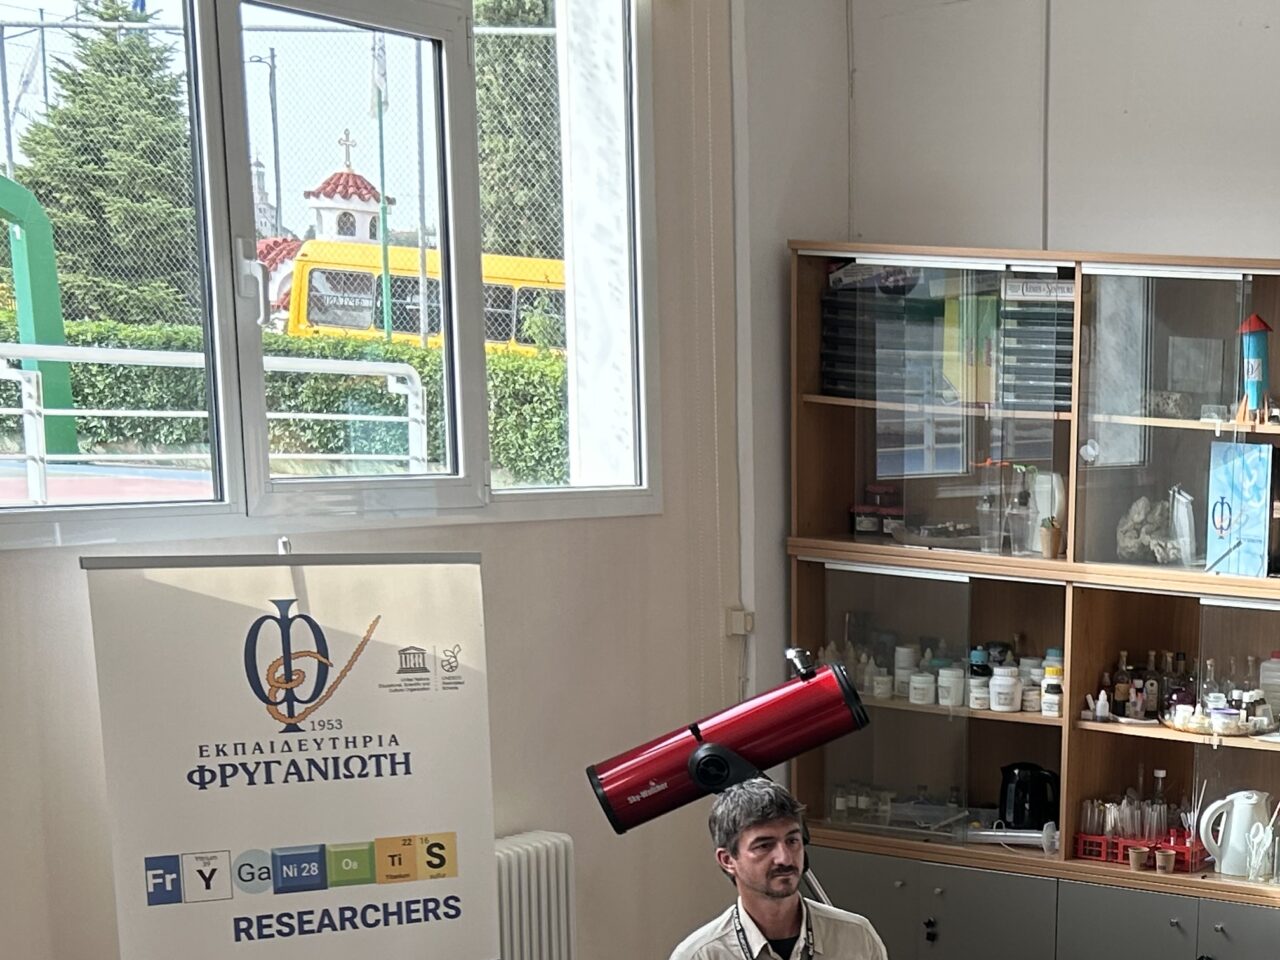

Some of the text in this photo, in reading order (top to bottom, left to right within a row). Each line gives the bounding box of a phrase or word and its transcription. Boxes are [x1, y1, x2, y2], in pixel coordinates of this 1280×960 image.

[309, 718, 343, 732] 1953
[198, 734, 400, 758] ΕΚΠΑΙΔΕΥΤΗΡΙΑ
[186, 752, 413, 790] ΦΡΥΓΑΝΙΩΤΗ
[401, 838, 412, 846] 22
[146, 869, 177, 893] Fr
[196, 868, 218, 890] Y
[237, 863, 271, 882] Ga
[282, 863, 298, 878] Ni
[300, 862, 319, 876] 28
[388, 853, 402, 867] Ti
[426, 842, 446, 869] S
[233, 895, 462, 942] RESEARCHERS
